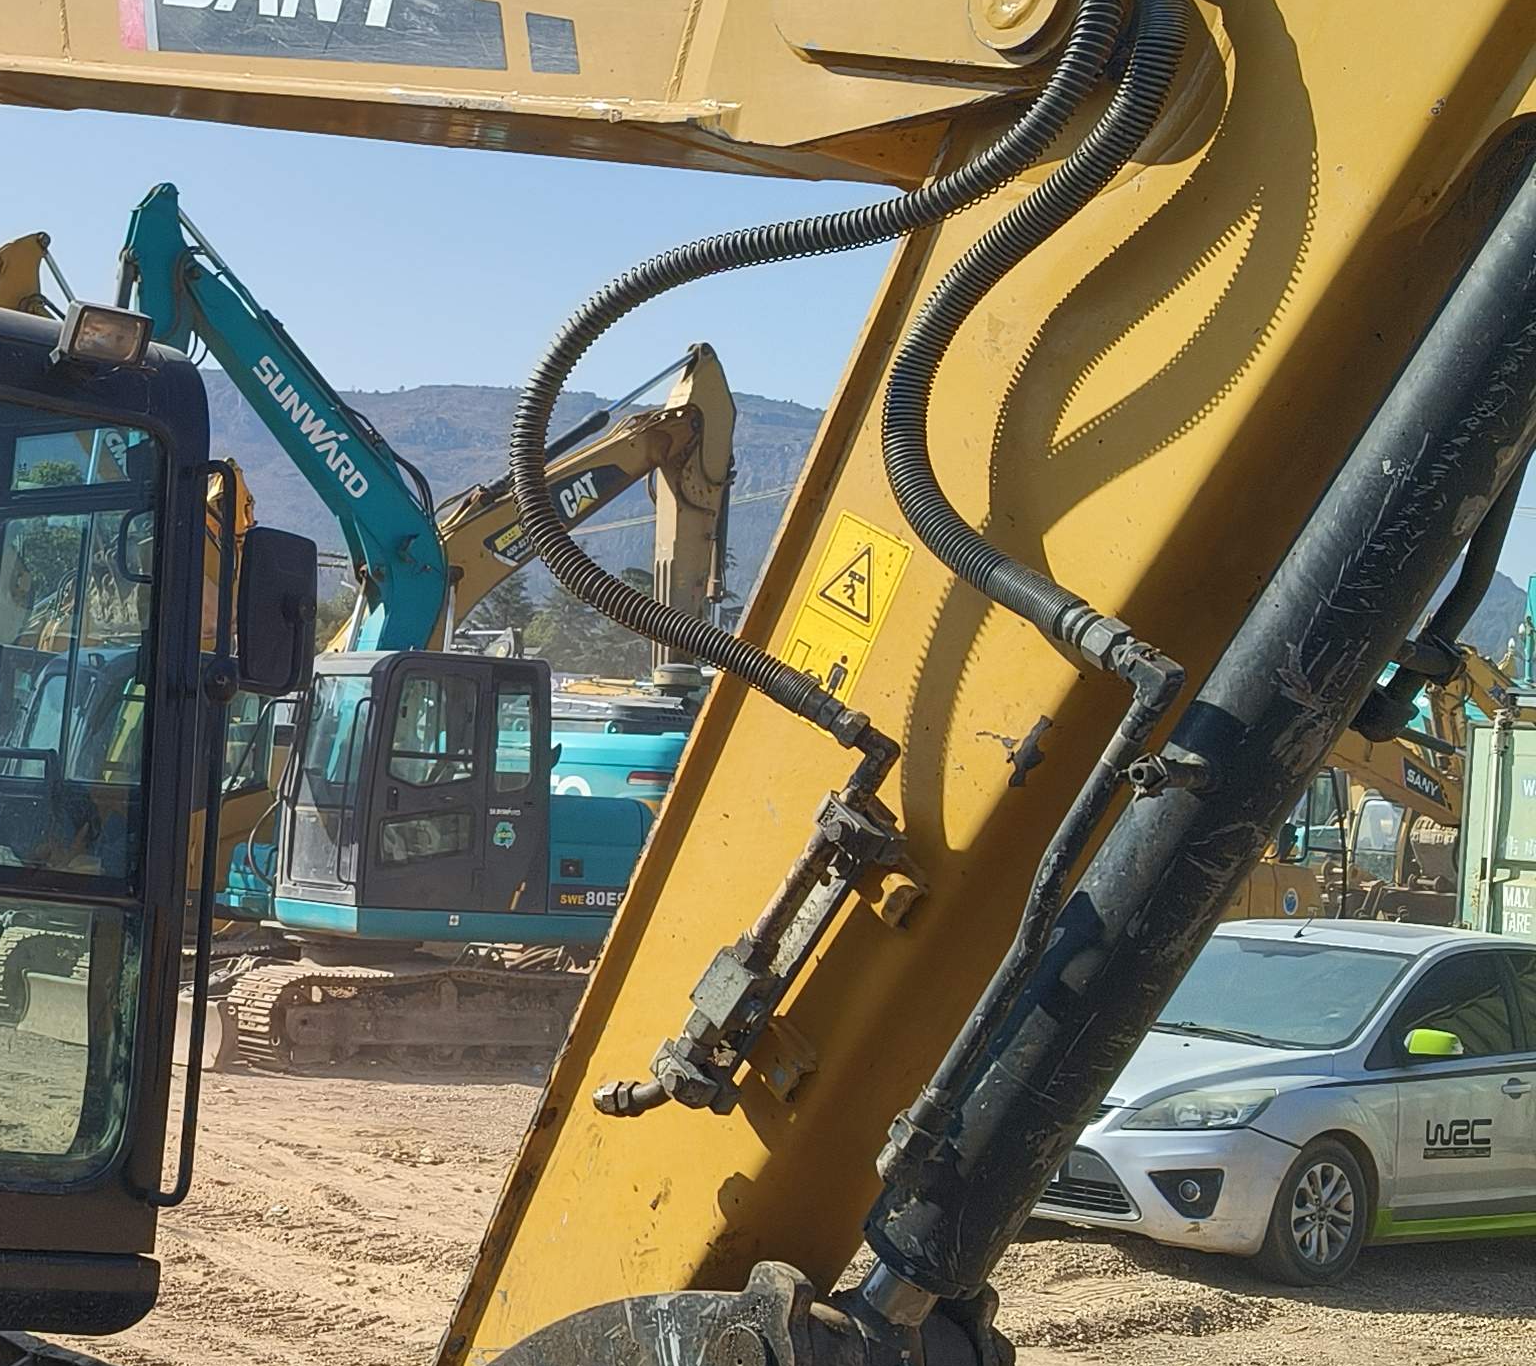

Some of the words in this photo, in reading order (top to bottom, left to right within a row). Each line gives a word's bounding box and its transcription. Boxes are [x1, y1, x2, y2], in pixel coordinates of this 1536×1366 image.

[252, 355, 369, 498] SUNWARD
[560, 471, 599, 519] CAT
[1406, 768, 1440, 797] SANY
[1502, 911, 1532, 934] TARE
[1426, 1118, 1492, 1146] WRC
